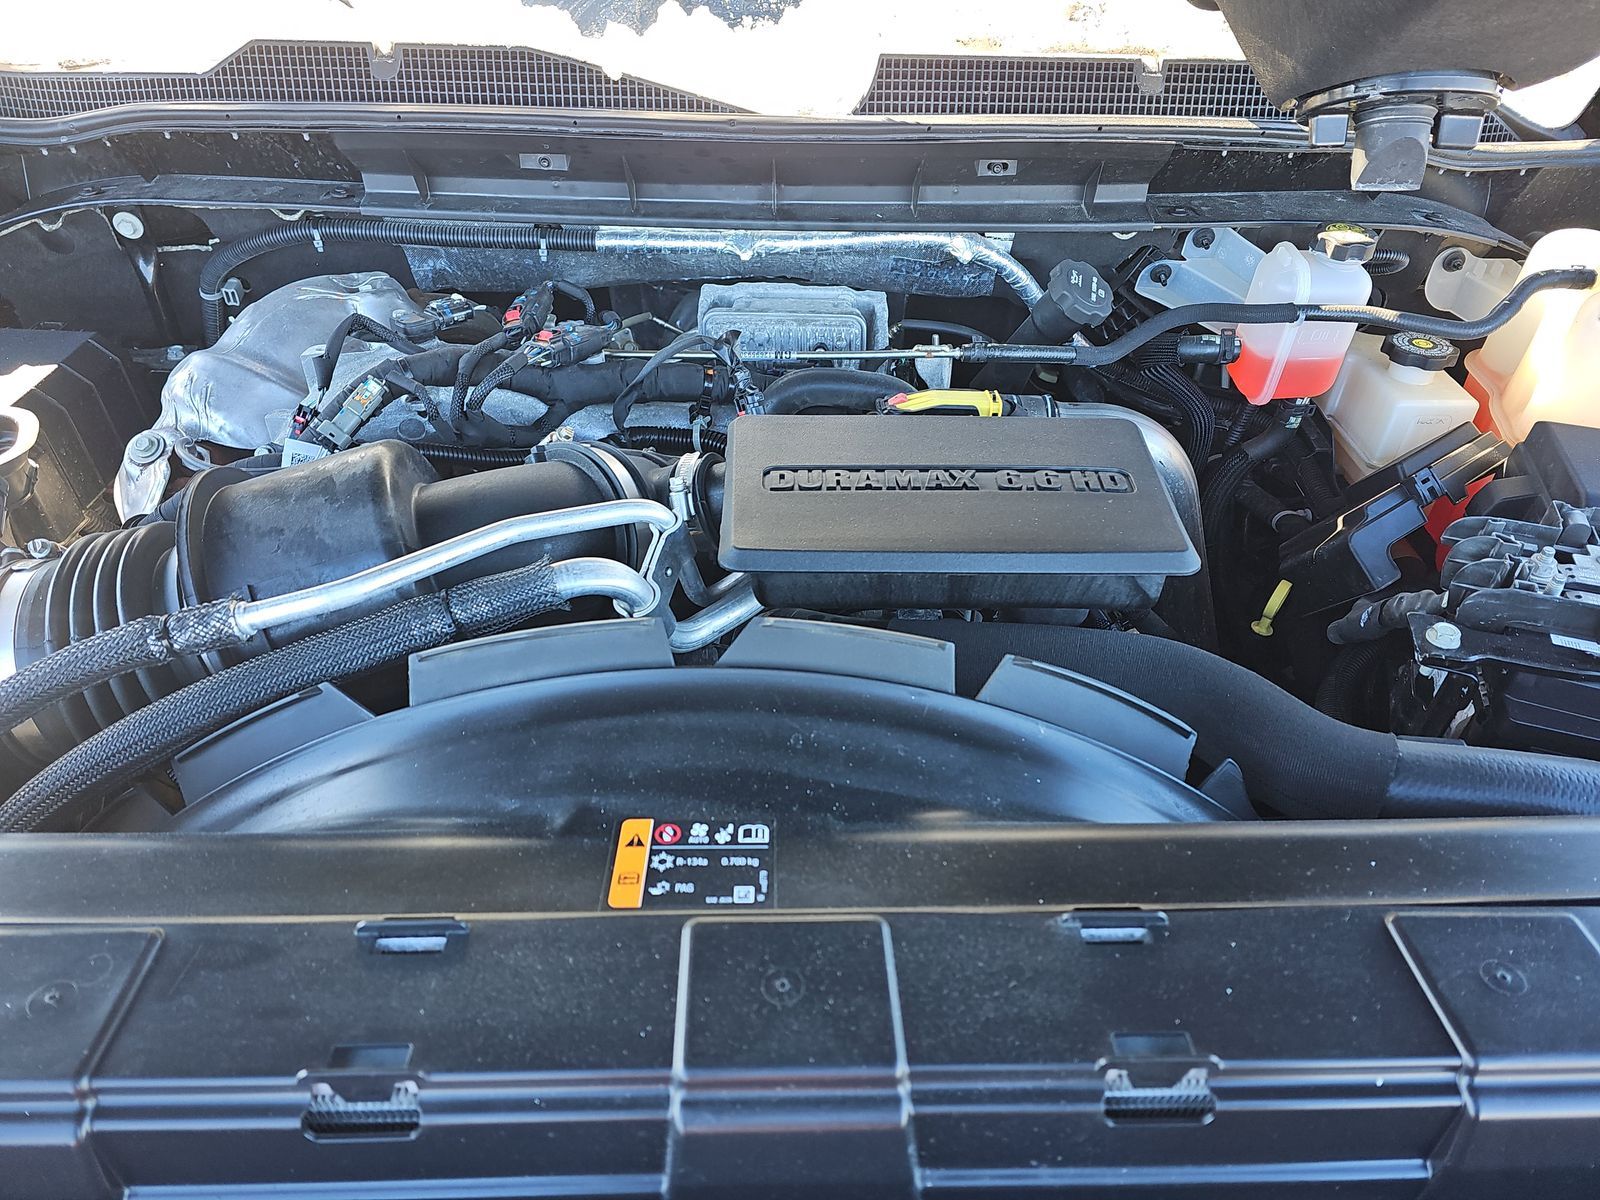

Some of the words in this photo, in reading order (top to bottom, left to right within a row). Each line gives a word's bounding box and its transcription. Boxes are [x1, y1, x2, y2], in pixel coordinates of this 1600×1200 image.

[768, 468, 980, 493] DURAMAX
[996, 468, 1062, 493] 6.6
[1073, 469, 1131, 494] HD
